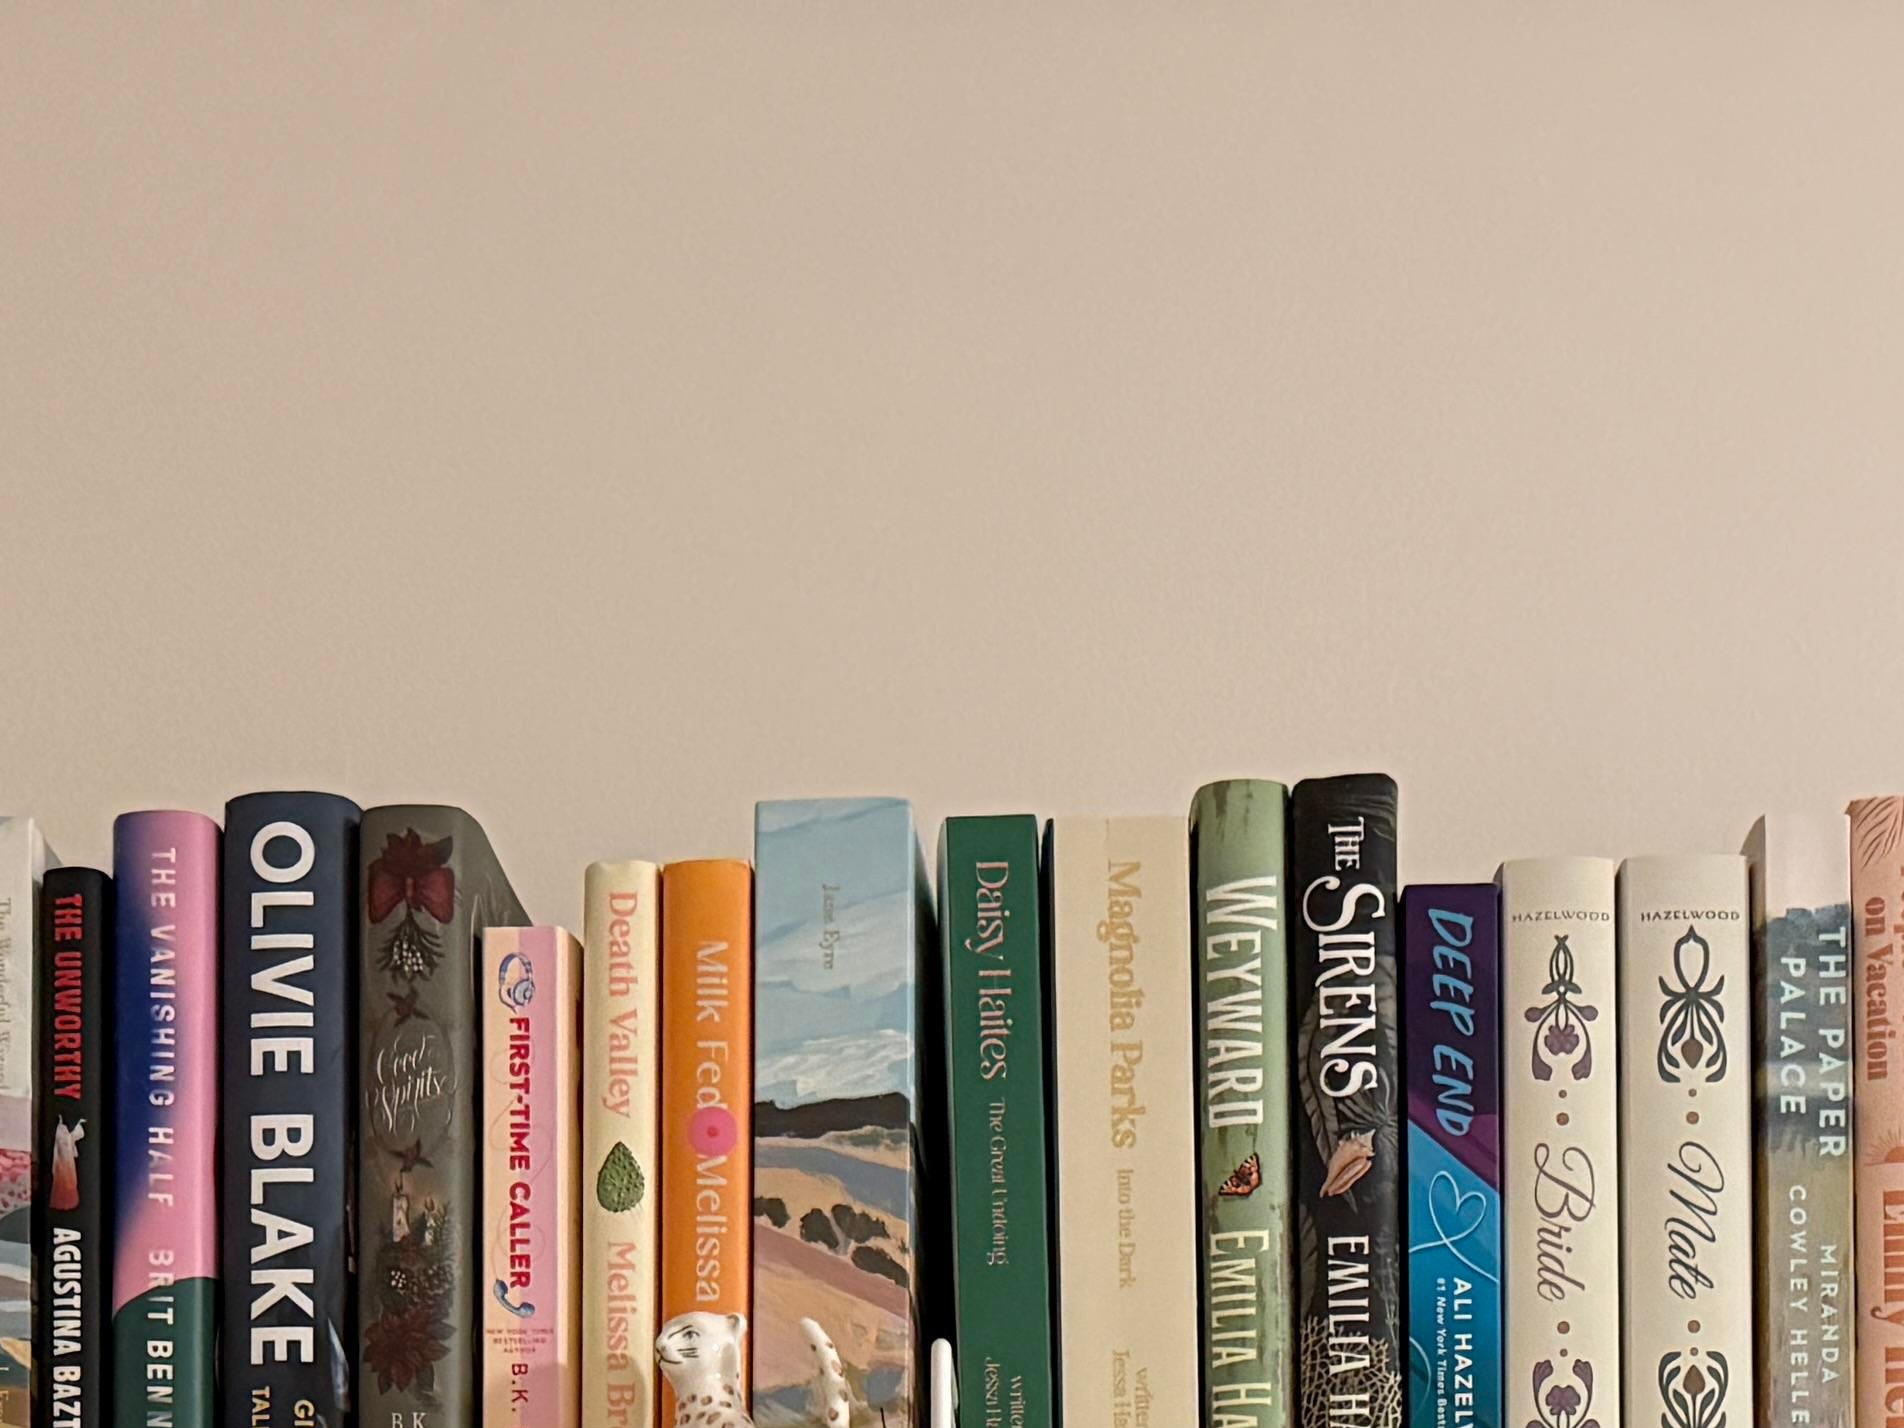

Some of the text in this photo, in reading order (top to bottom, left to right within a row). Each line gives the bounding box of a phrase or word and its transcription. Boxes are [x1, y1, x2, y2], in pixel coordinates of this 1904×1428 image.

[52, 893, 84, 1101] THE UNWORTHY
[1204, 874, 1278, 1128] WEYWARD
[1301, 815, 1387, 1099] THE SIRENS
[1511, 911, 1611, 923] HAZELWOOD
[1639, 909, 1742, 923] HAZELWOOD
[248, 819, 318, 1367] OLIVIE BLAKE
[1426, 906, 1475, 1138] DEEP END
[51, 1227, 84, 1359] AGUSTINA
[1208, 1229, 1269, 1369] EMILIA
[1452, 1278, 1473, 1322] ALI
